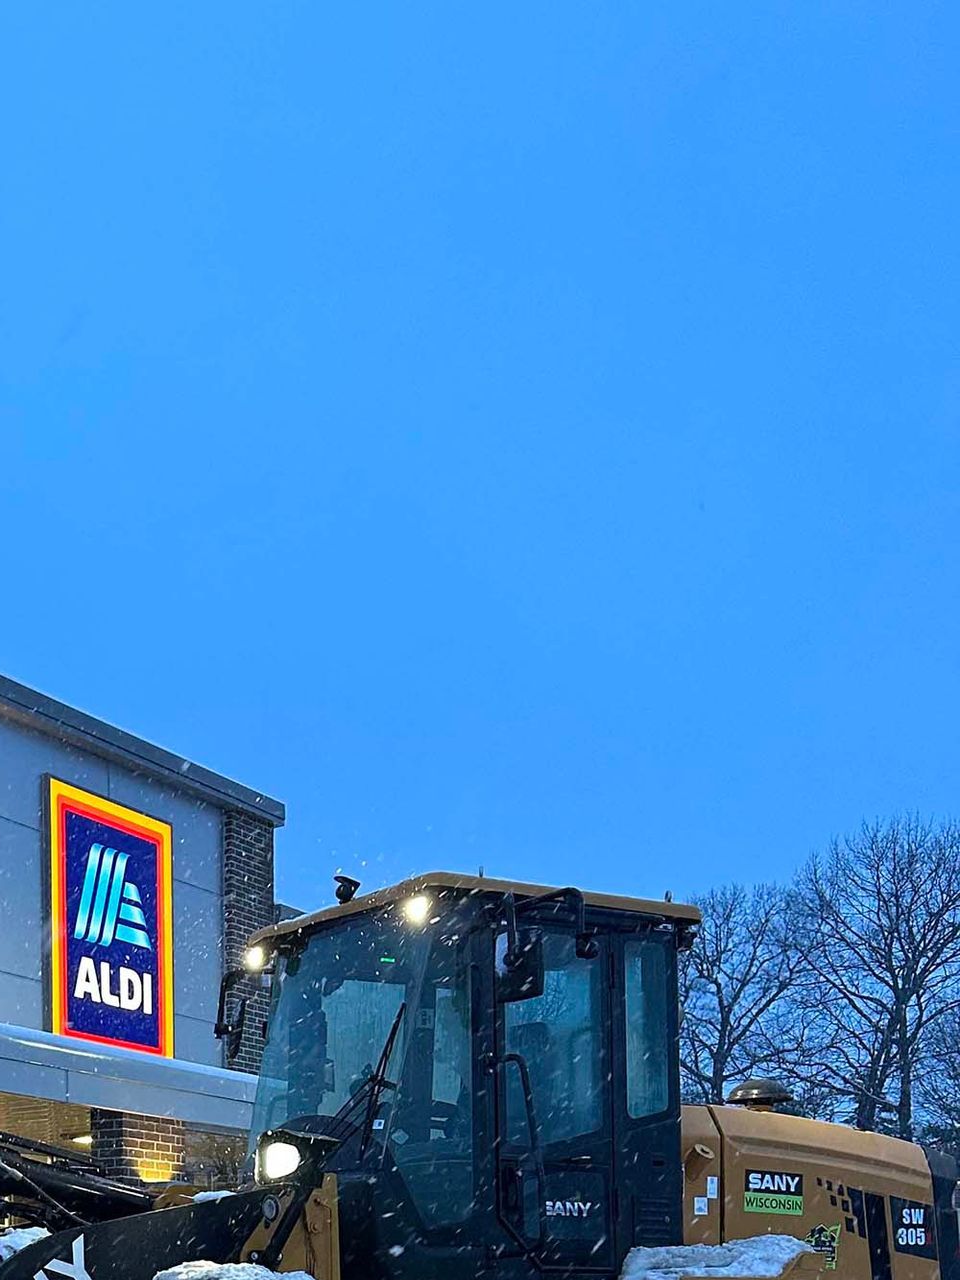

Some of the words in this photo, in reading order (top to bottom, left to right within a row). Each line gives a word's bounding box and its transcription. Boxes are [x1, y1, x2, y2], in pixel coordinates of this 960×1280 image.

[73, 956, 152, 1015] ALDI
[748, 1172, 800, 1192] SANY
[545, 1200, 591, 1217] SANY
[745, 1195, 803, 1211] WISCONSIN
[902, 1208, 925, 1225] SW
